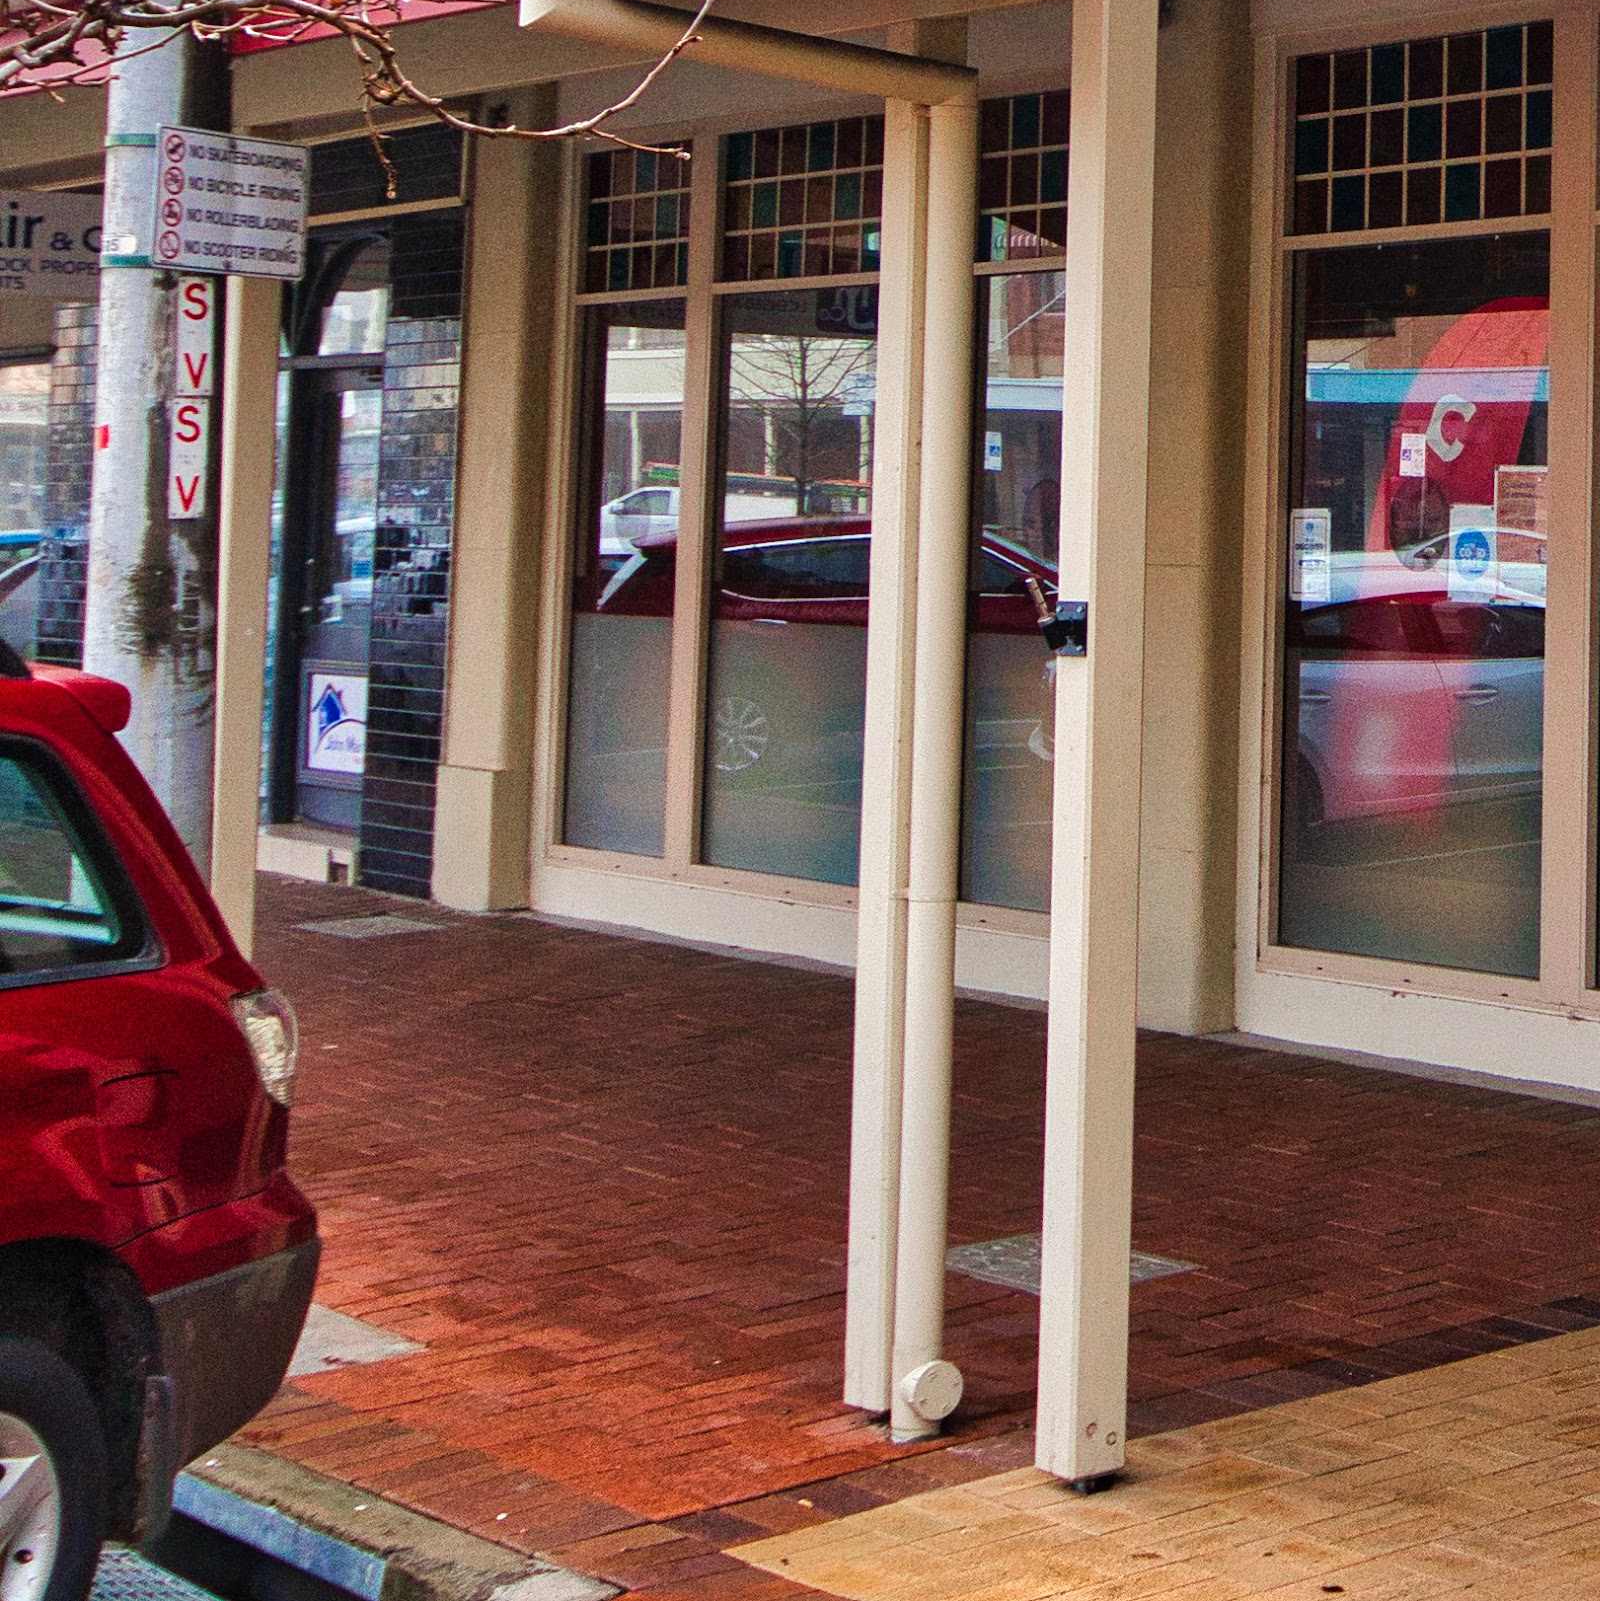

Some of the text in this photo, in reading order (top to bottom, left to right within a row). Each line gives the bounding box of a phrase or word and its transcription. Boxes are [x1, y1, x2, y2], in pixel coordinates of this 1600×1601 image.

[189, 144, 302, 171] NO SKATEBOARDING
[188, 176, 301, 202] NO BICYCLE RIDING
[0, 201, 44, 248] ir
[187, 208, 299, 233] NO ROLLERBLADING
[184, 240, 298, 264] NO SCOOTER RIDING
[183, 282, 208, 389] S V
[175, 405, 201, 512] S V
